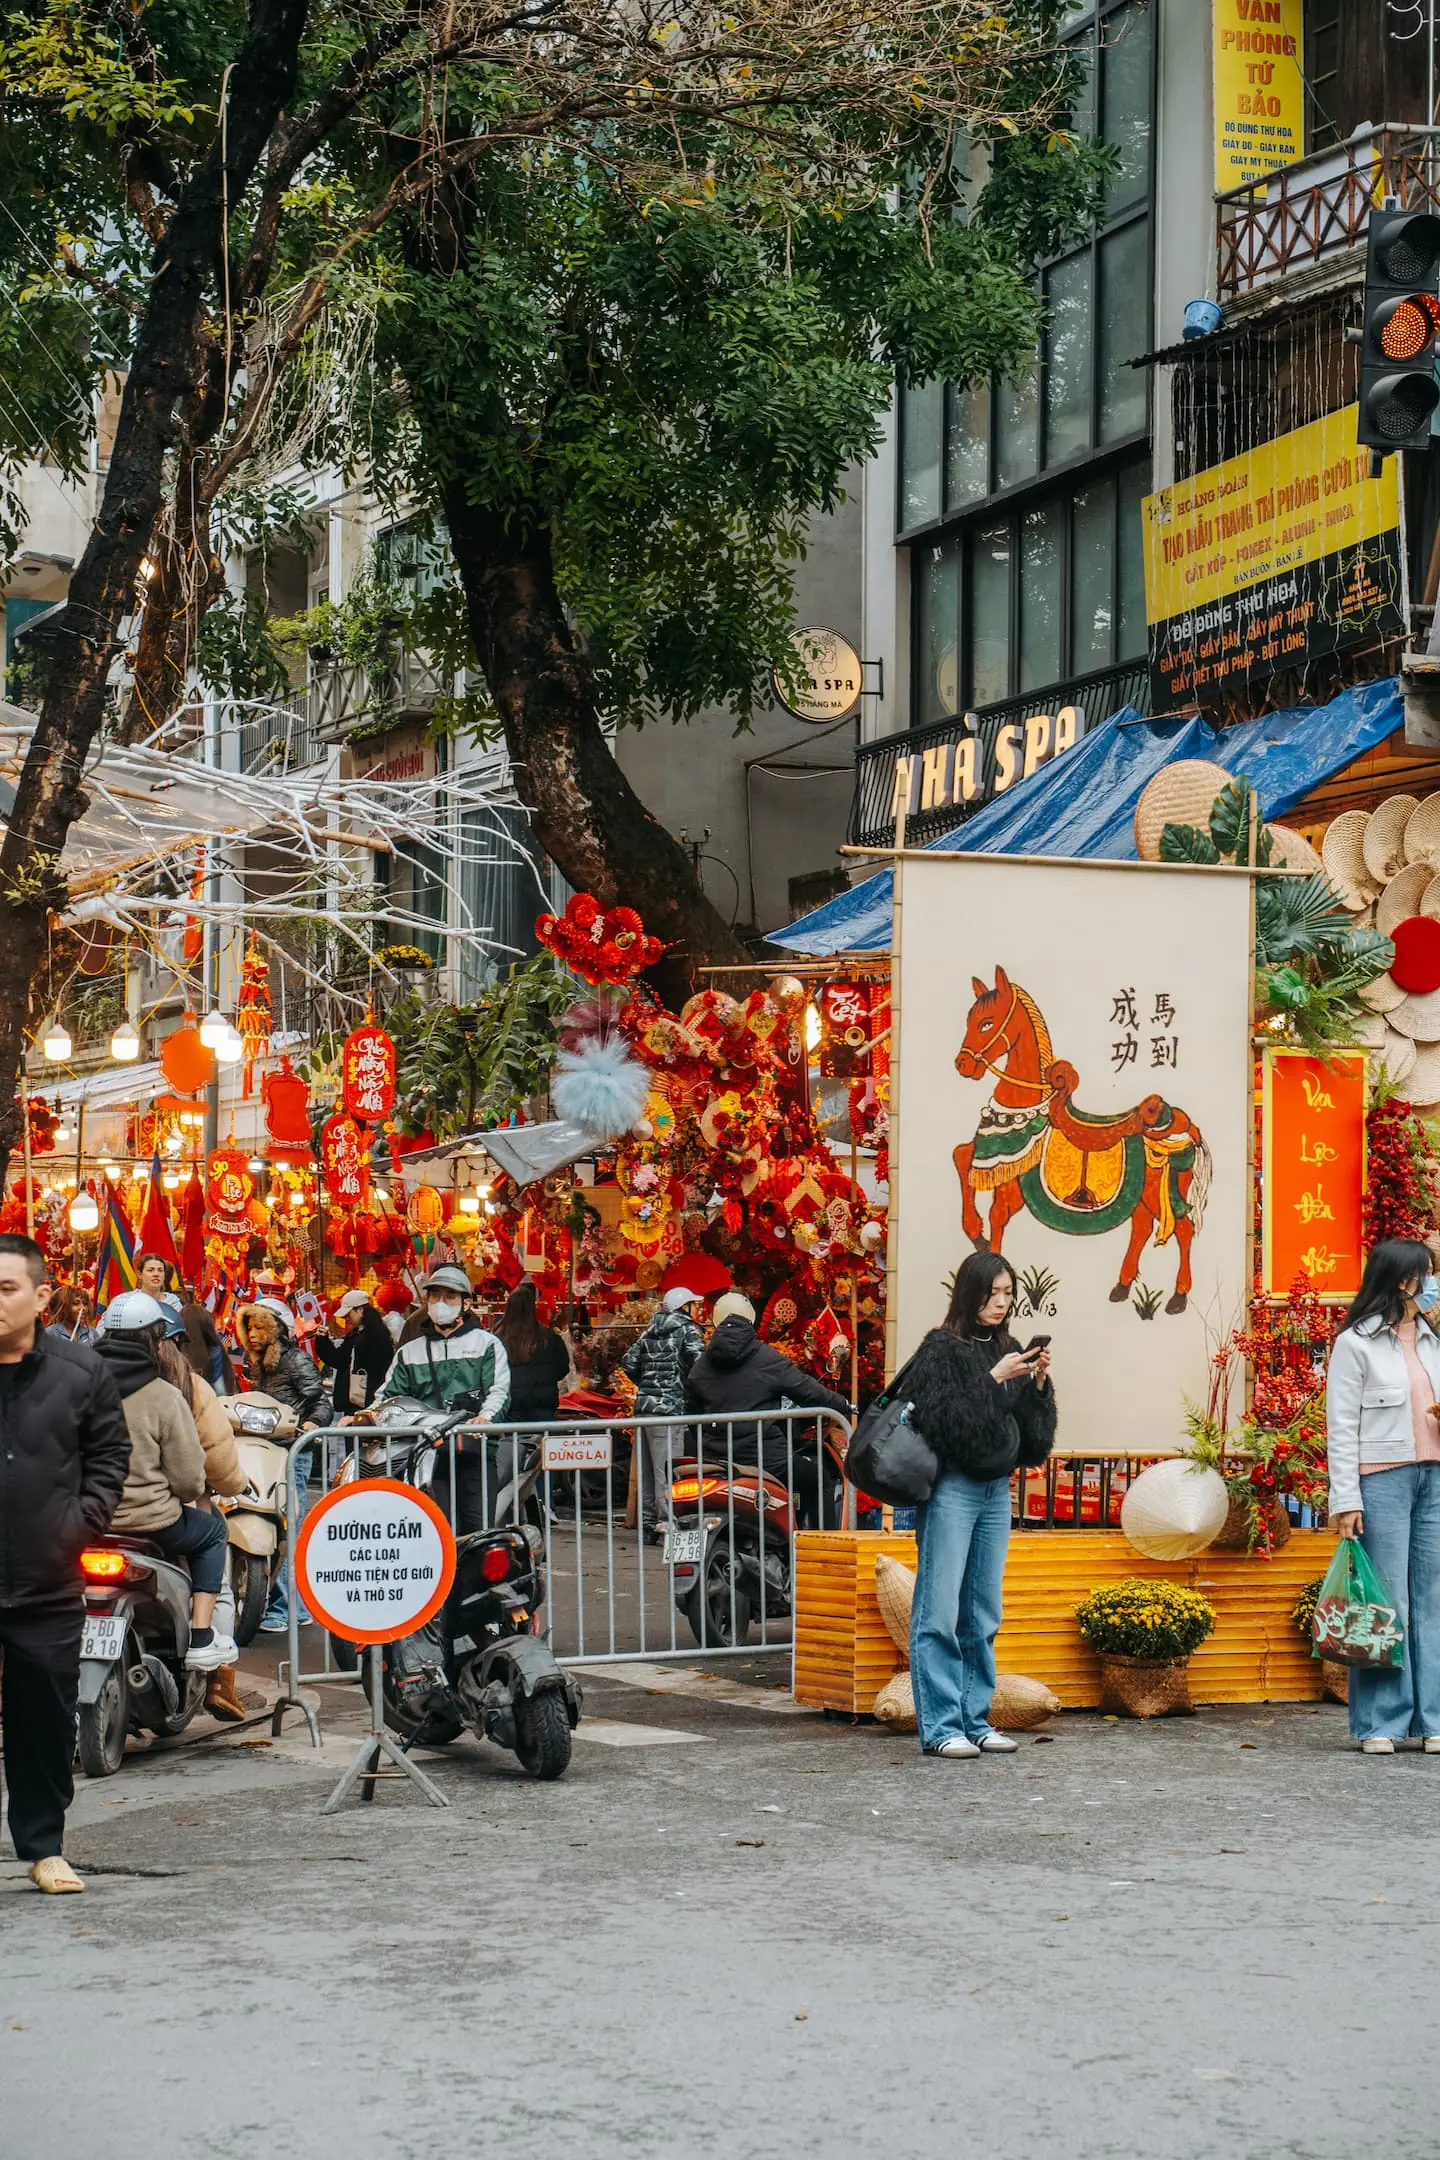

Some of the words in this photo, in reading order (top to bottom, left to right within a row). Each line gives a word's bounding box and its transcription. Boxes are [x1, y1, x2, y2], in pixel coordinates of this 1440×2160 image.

[1221, 27, 1297, 56] PHÒNG
[1237, 89, 1281, 118] BẢO
[1162, 531, 1185, 567] TẠO
[1215, 503, 1254, 542] TRANG
[1277, 473, 1319, 516] PHÒNG
[824, 679, 855, 691] SPA
[892, 713, 984, 817] NHÀ
[995, 706, 1085, 792] SPA
[1109, 987, 1141, 1073] 成功
[586, 1450, 607, 1462] LẠI
[328, 1520, 381, 1541] ĐƯỜNG
[387, 1517, 422, 1539] CẤM
[350, 1547, 372, 1562] CÁC
[375, 1549, 400, 1563] LOẠI
[316, 1569, 361, 1583] PHƯƠNG
[365, 1566, 389, 1583] TIỆN
[393, 1568, 408, 1581] CƠ
[411, 1565, 433, 1580] GIỚI
[346, 1588, 361, 1602] VÀ
[364, 1588, 385, 1602] THÔ
[388, 1588, 404, 1601] SƠ
